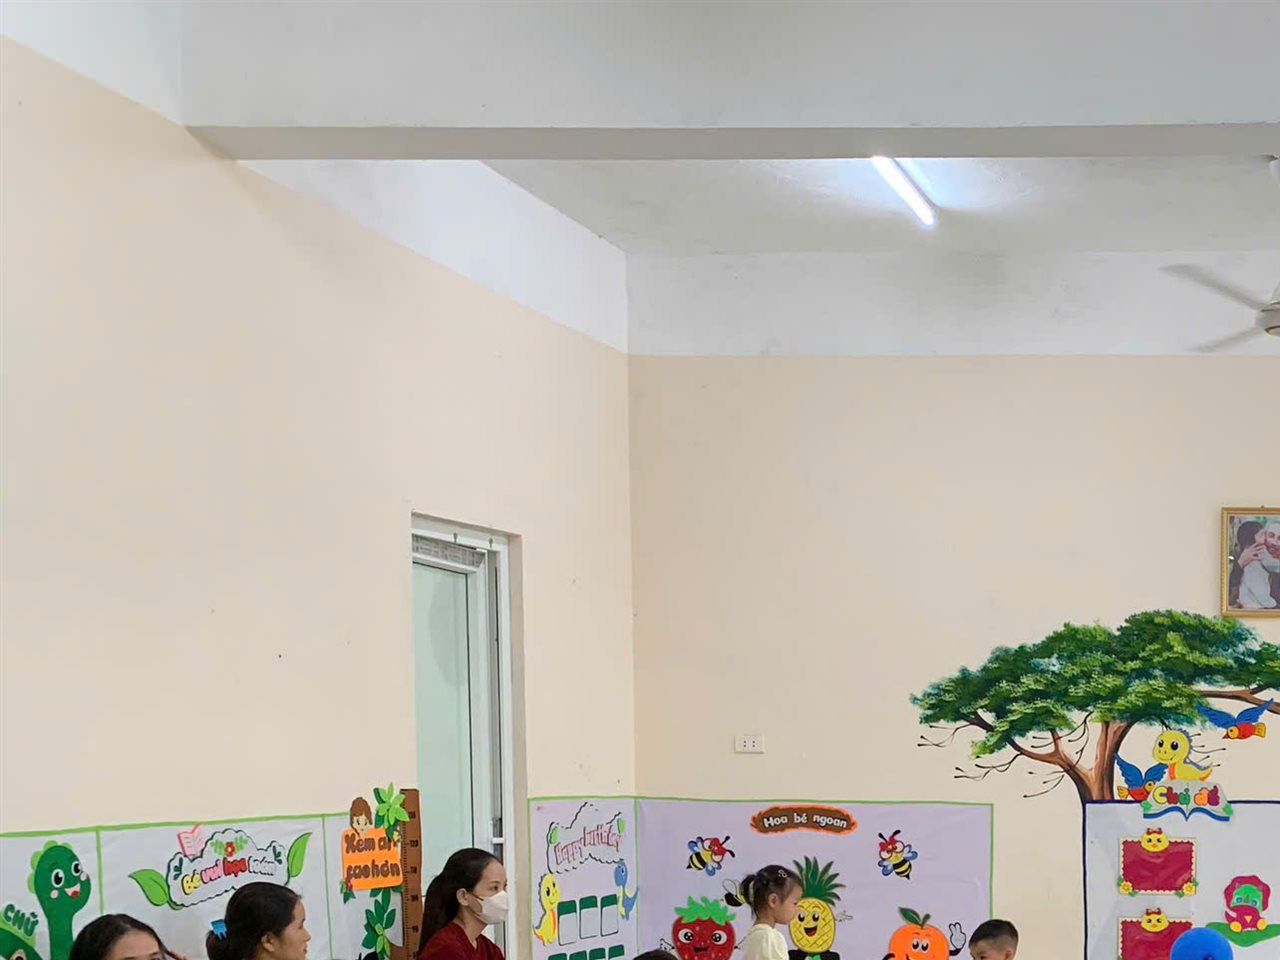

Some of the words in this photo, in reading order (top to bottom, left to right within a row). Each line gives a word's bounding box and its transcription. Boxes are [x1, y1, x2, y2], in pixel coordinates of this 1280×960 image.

[763, 815, 789, 828] Hoa
[793, 812, 808, 823] bé
[812, 814, 848, 828] ngoan
[344, 832, 376, 854] Xem
